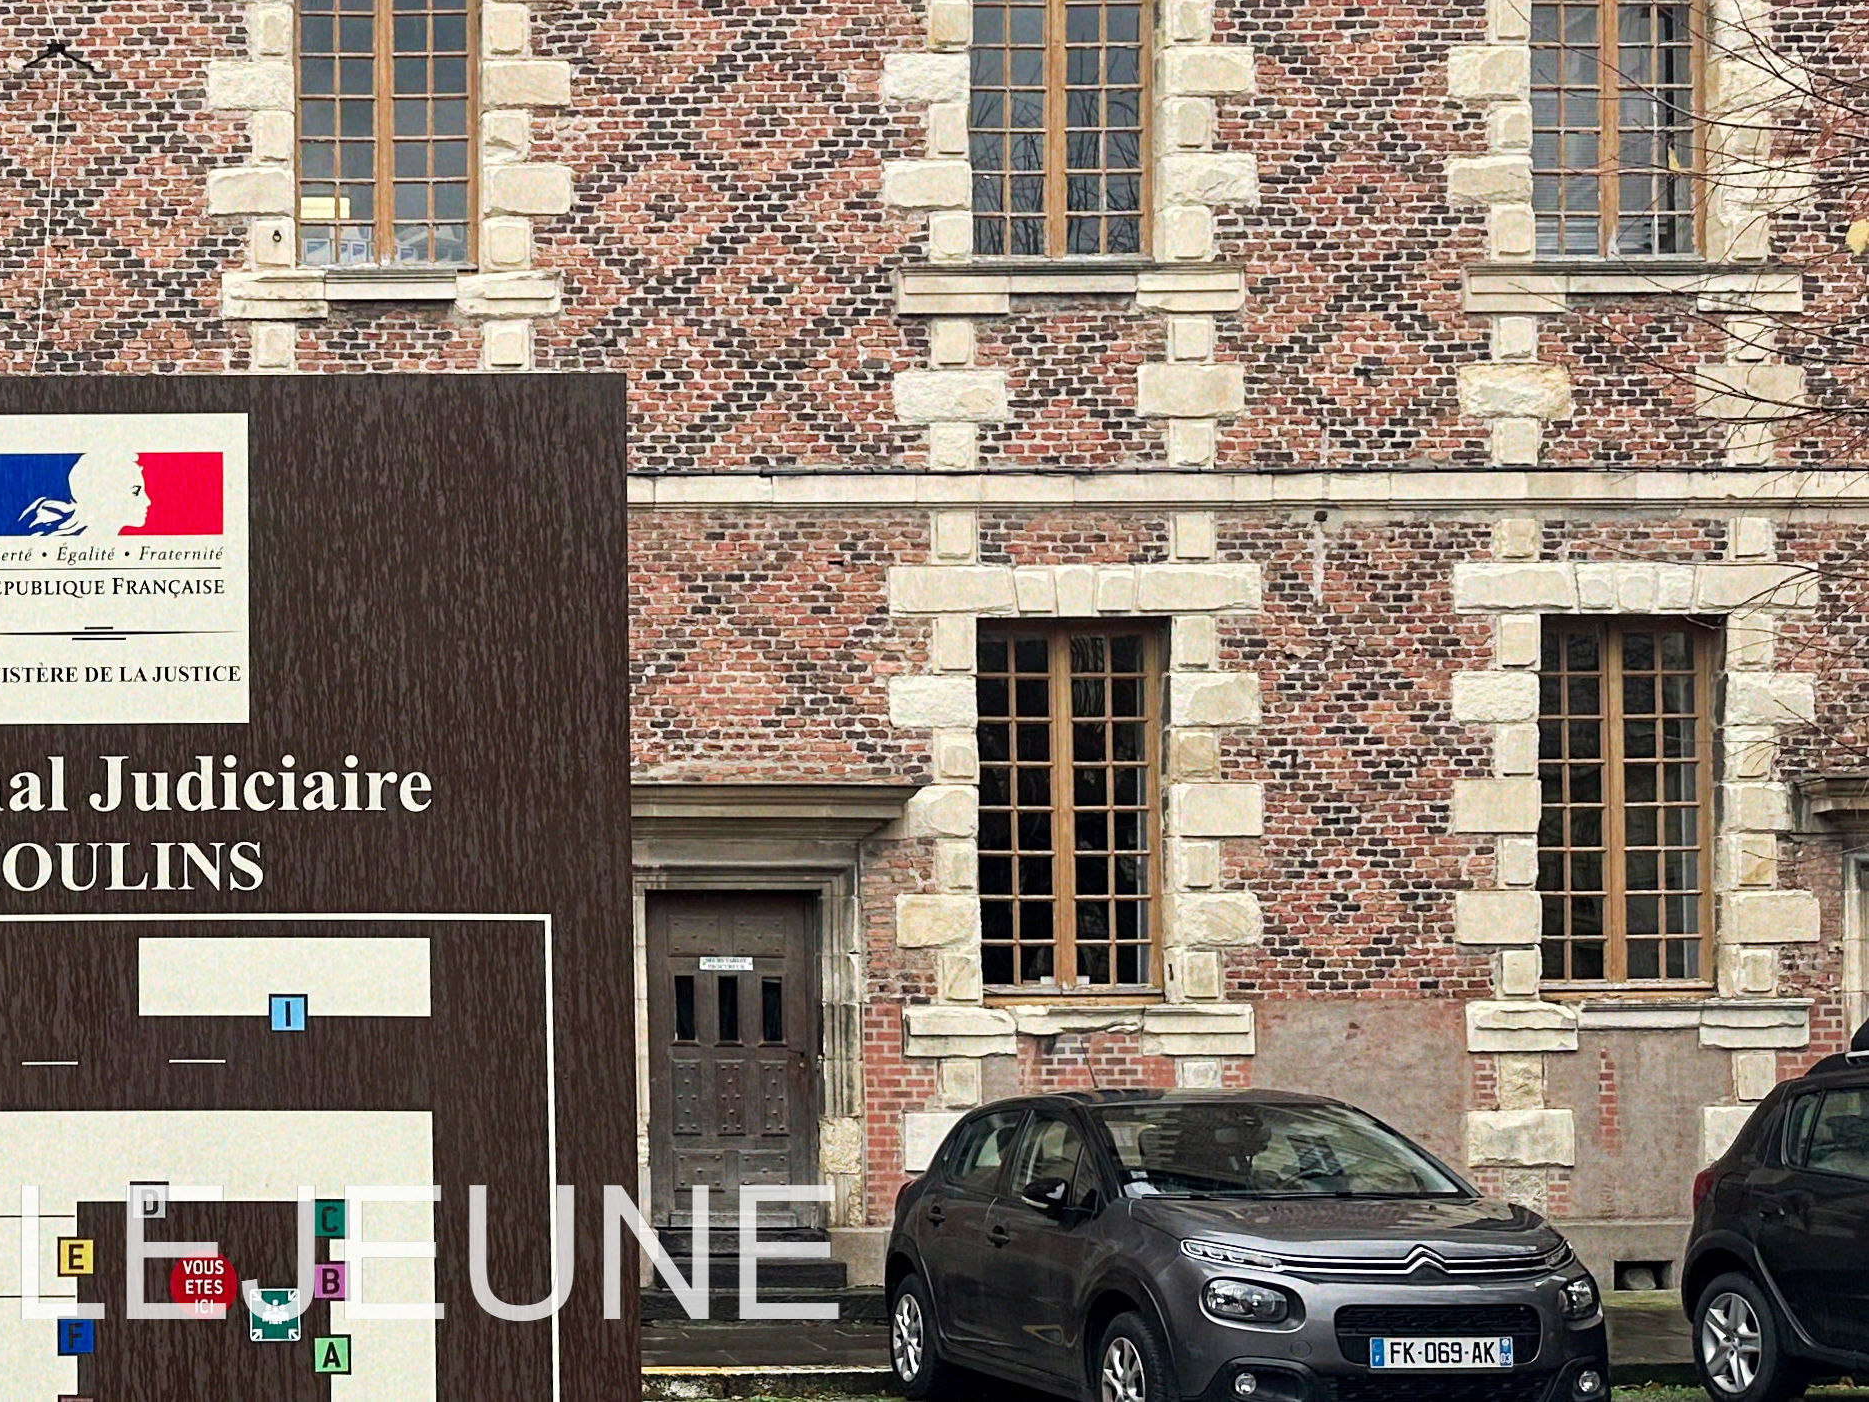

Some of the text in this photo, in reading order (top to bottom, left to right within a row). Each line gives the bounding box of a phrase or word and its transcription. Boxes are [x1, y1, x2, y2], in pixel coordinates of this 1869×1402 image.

[56, 542, 116, 566] Égalité
[138, 545, 223, 562] Fraternité
[111, 577, 225, 599] FRANÇAISE
[84, 666, 114, 683] DE
[119, 666, 148, 683] LA
[152, 665, 242, 683] JUSTICE
[89, 754, 433, 813] Judiciaire
[140, 1189, 159, 1216] D
[320, 1205, 339, 1234] C
[68, 1243, 85, 1270] E
[182, 1259, 225, 1276] VOUS
[184, 1279, 224, 1296] ETES
[321, 1268, 340, 1295] B
[194, 1299, 214, 1315] ICI
[68, 1322, 85, 1348] F
[321, 1341, 343, 1369] A
[1389, 1341, 1496, 1364] FK-069-AK
